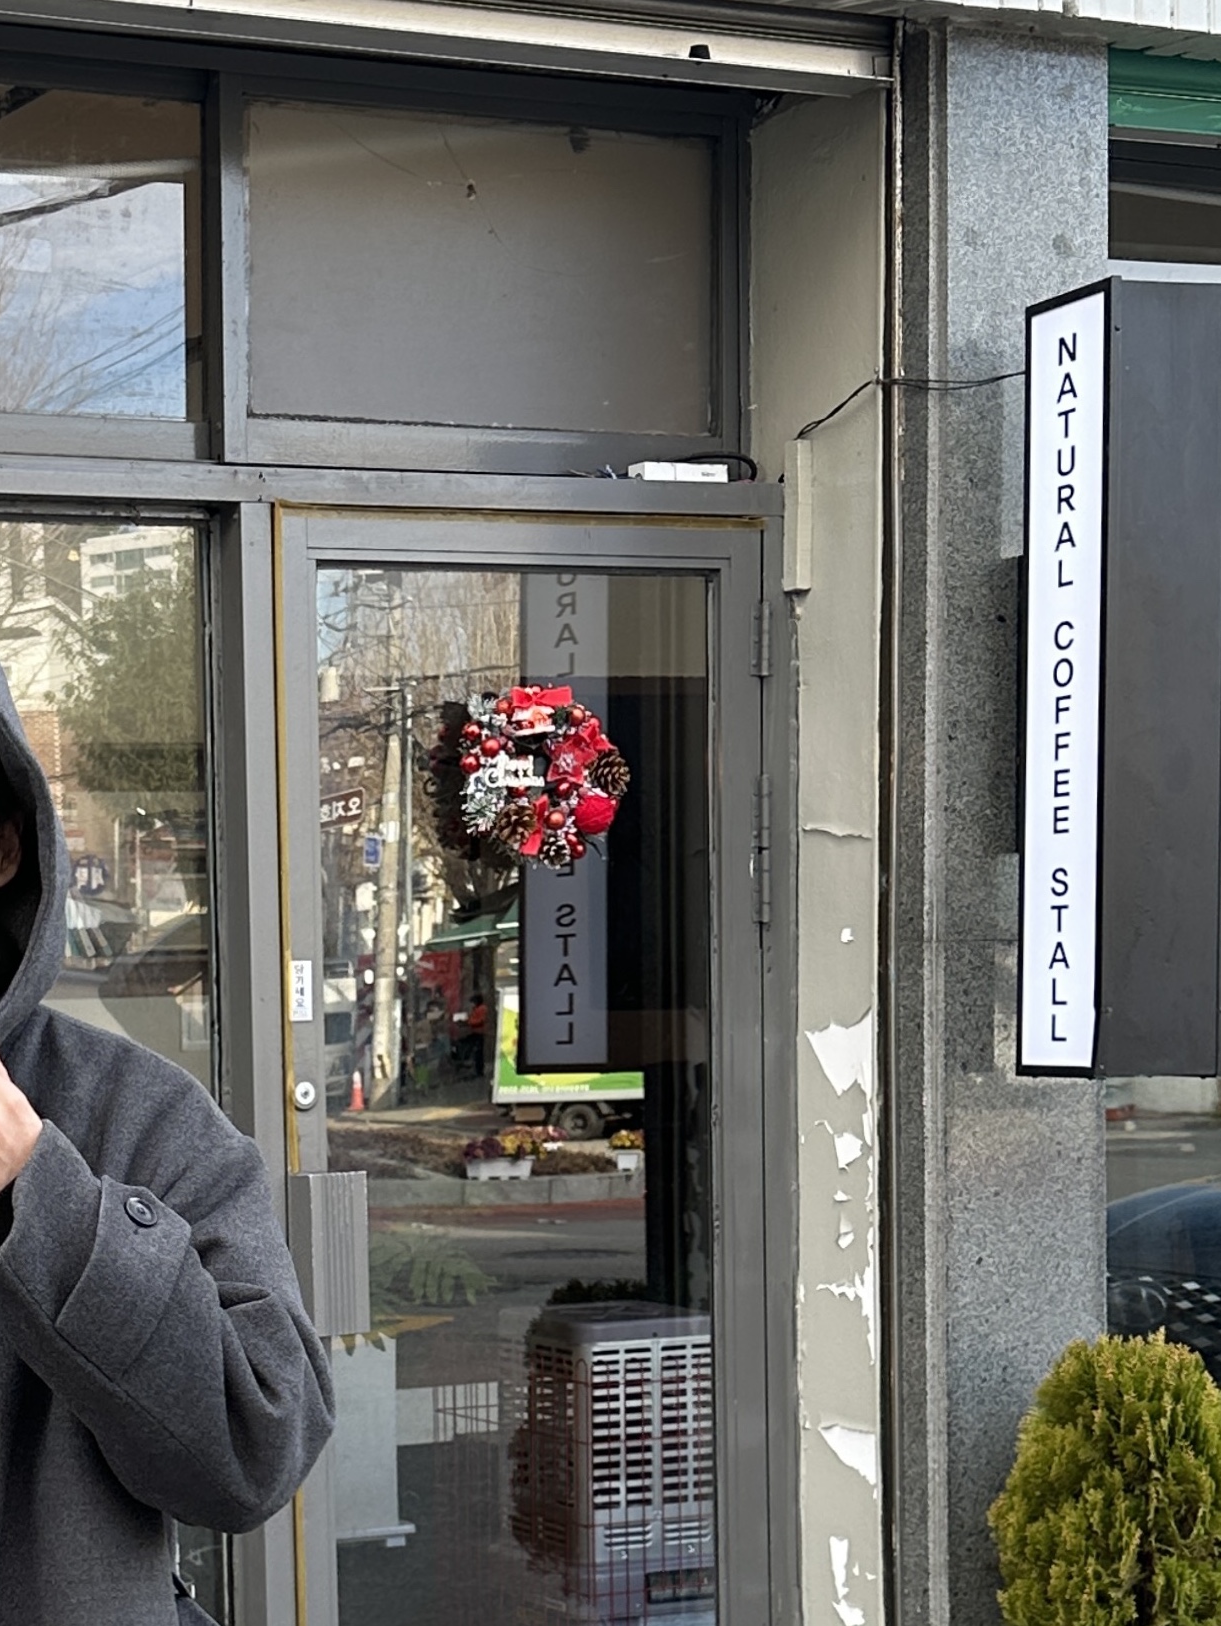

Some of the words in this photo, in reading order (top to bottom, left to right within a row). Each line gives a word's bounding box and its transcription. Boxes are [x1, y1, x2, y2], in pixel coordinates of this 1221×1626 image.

[1056, 332, 1078, 588] NATURAL
[1052, 620, 1075, 835] COFFEE
[1048, 867, 1070, 1043] STALL
